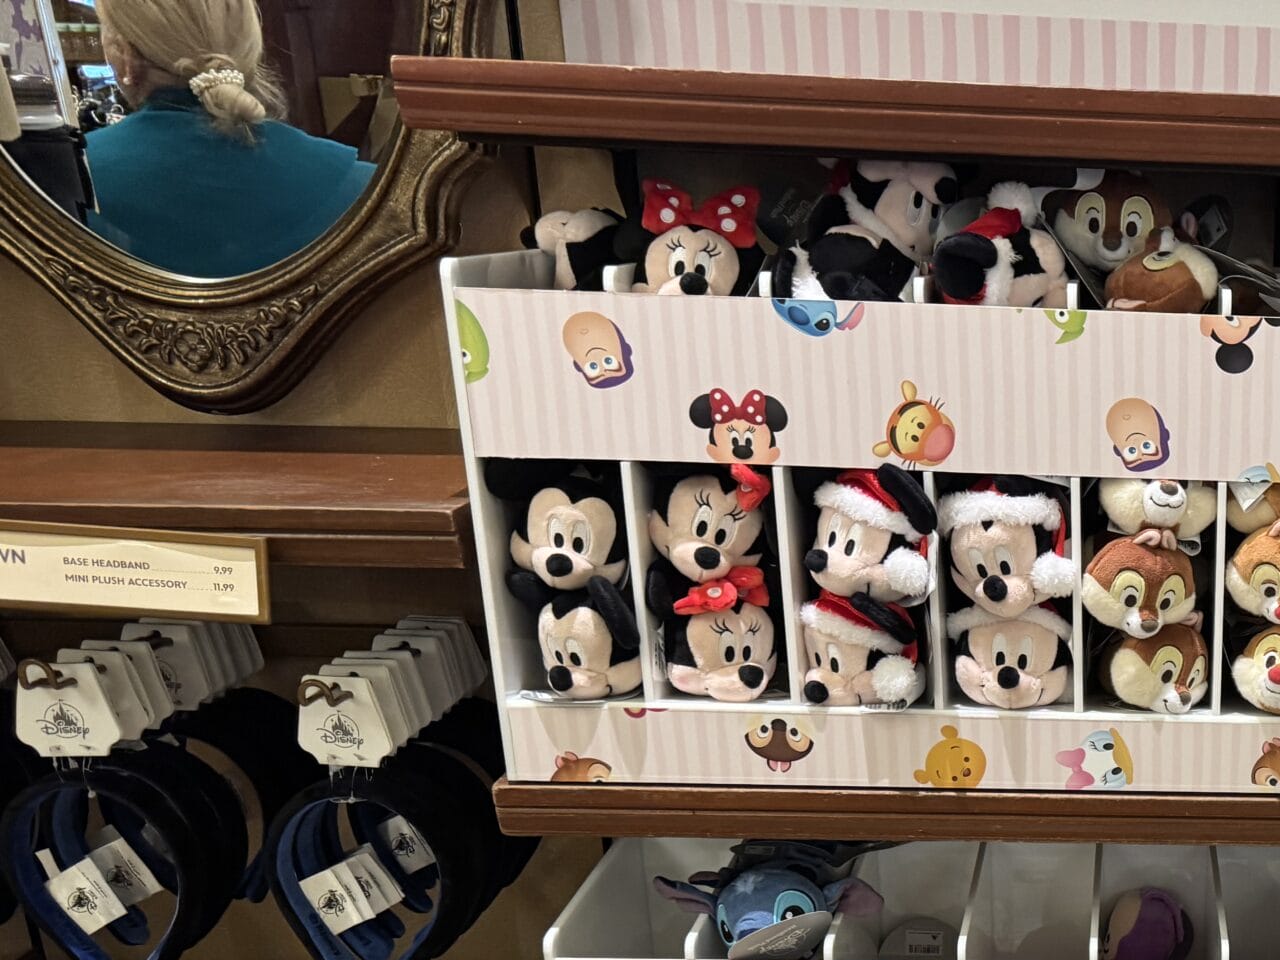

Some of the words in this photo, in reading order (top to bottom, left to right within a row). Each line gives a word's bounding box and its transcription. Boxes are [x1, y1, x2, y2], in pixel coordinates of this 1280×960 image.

[63, 557, 89, 567] BASE
[91, 558, 150, 571] HEADBAND
[213, 566, 233, 575] 9.99
[65, 573, 89, 583] MINI
[92, 575, 125, 586] PLUSH
[128, 577, 188, 589] ACCESSORY
[213, 582, 235, 592] 11.99
[36, 719, 90, 740] Disney
[316, 728, 364, 750] Disney
